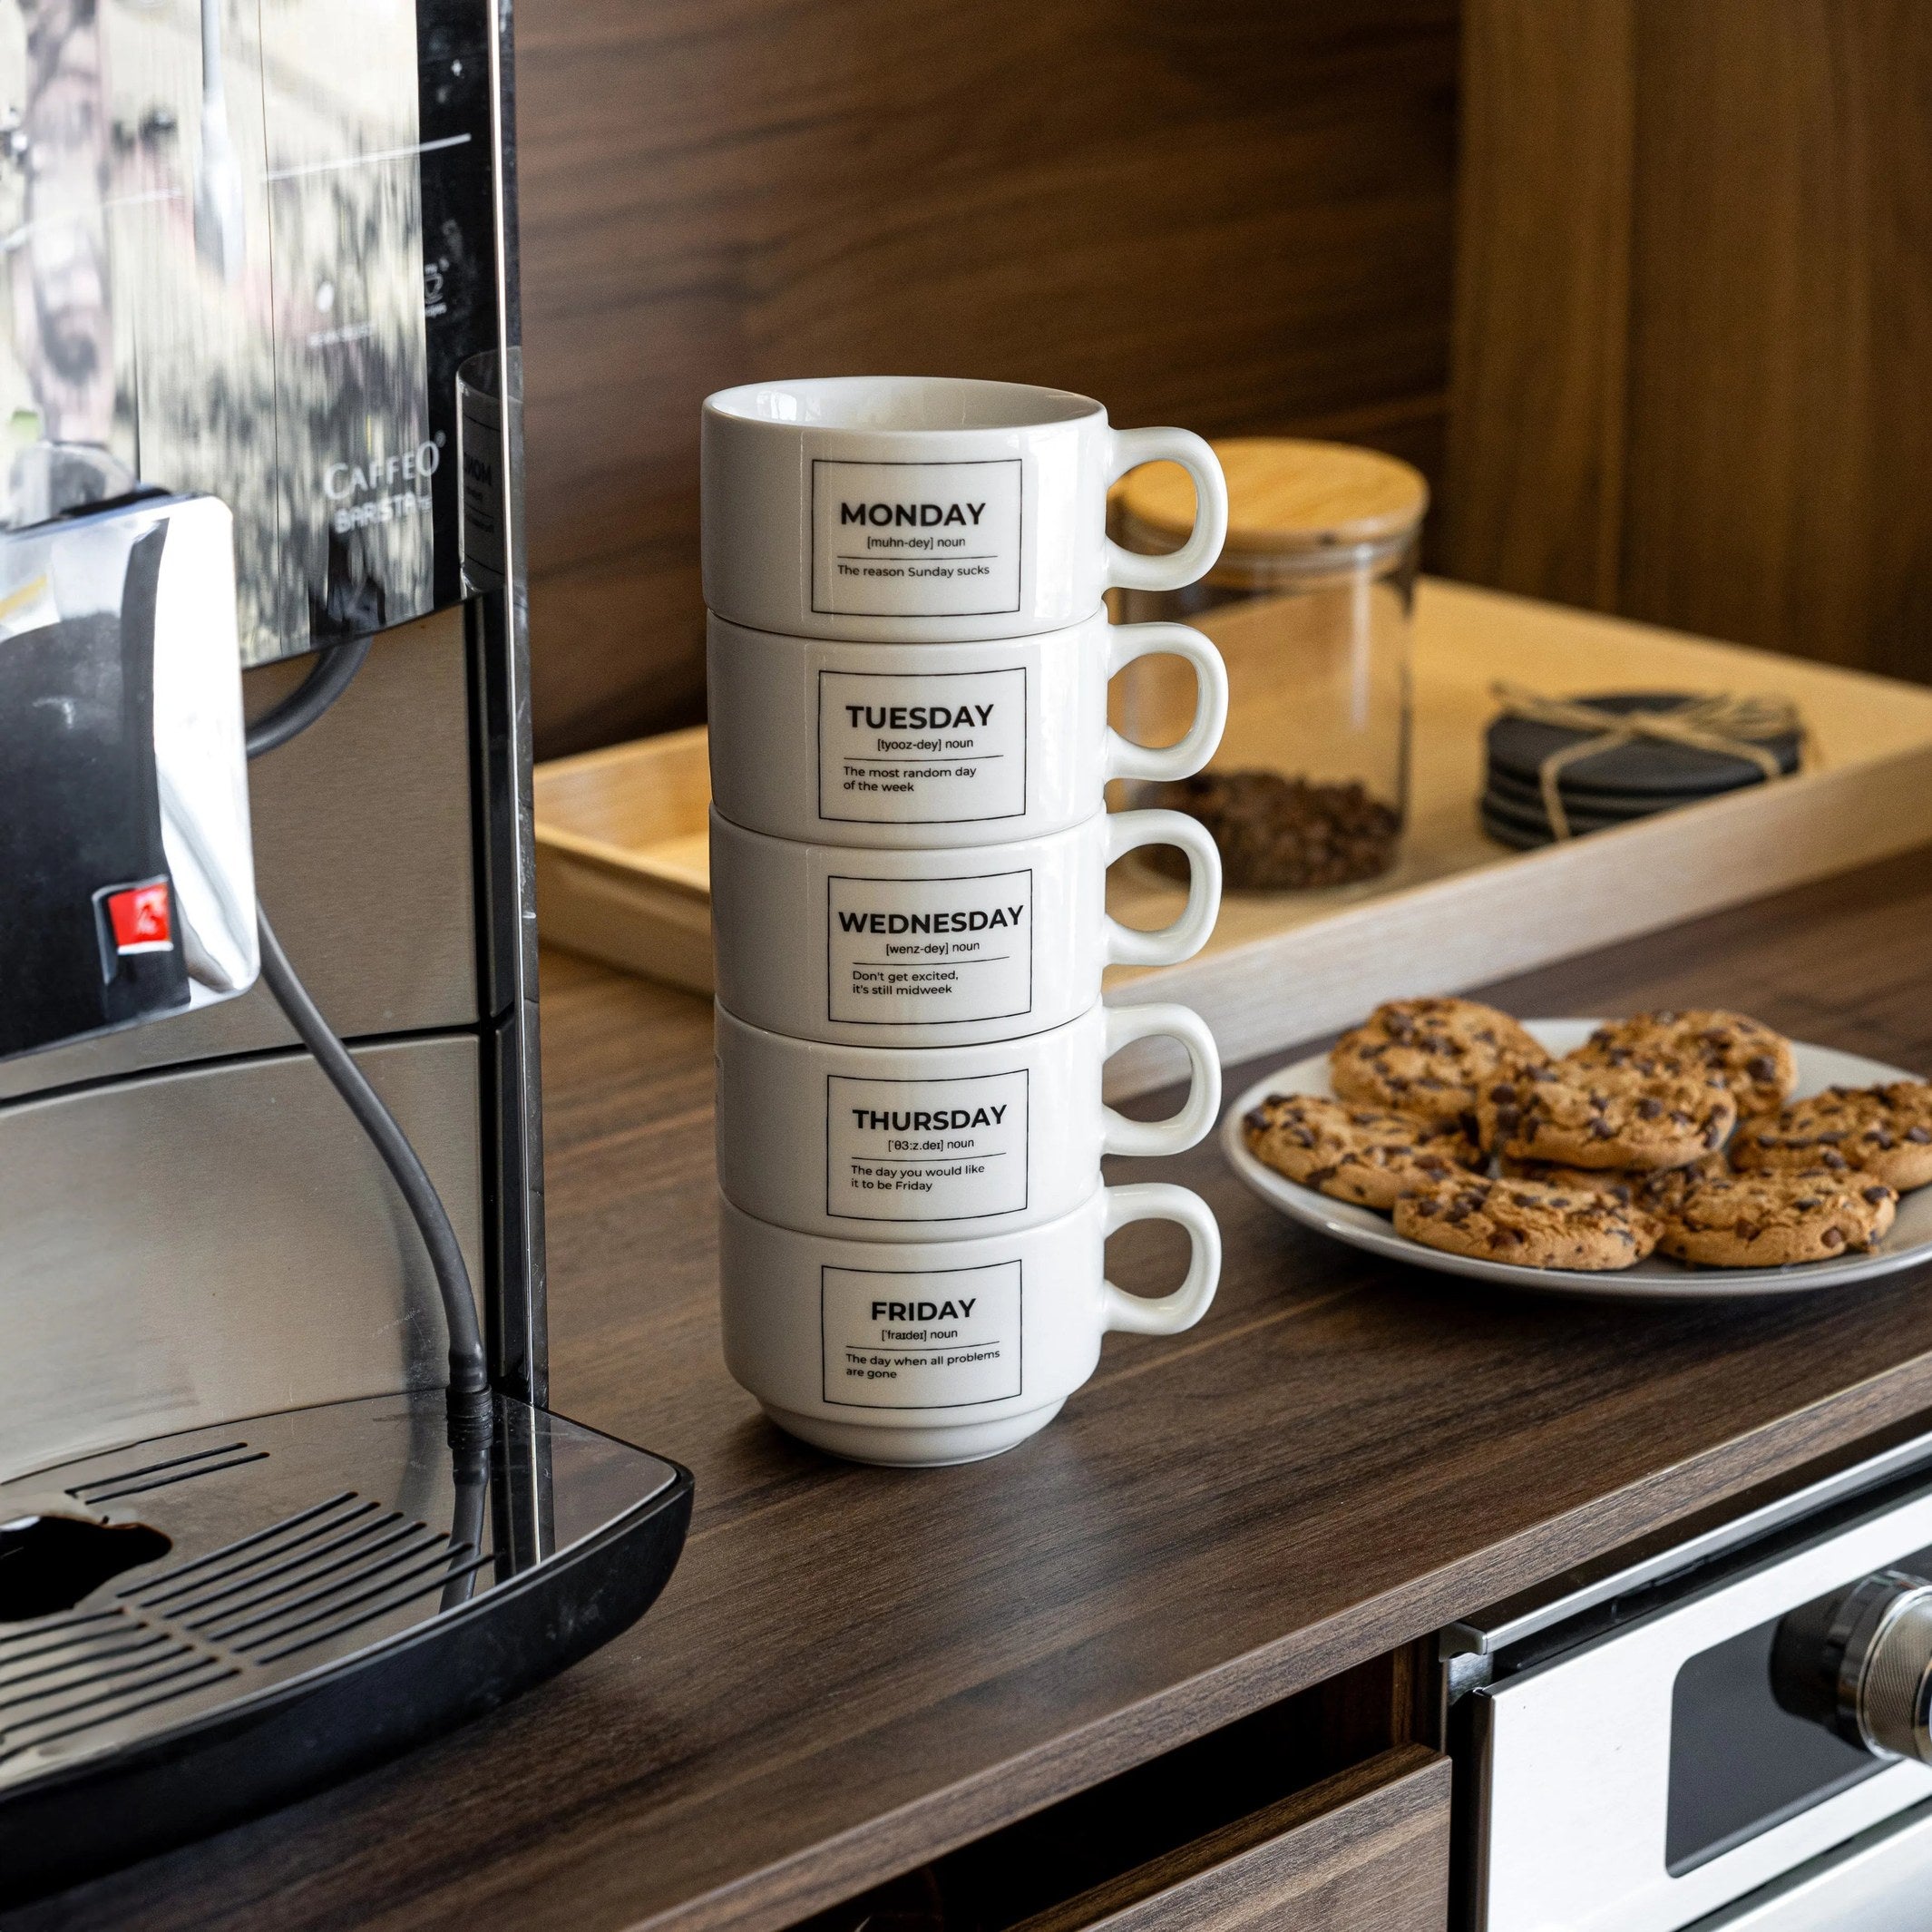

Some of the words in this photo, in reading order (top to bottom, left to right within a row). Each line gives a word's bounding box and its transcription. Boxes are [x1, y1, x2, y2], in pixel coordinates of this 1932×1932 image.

[840, 503, 986, 527] MONDAY
[867, 536, 933, 551] [muhn-dey]
[937, 538, 966, 548] noun
[837, 564, 860, 576] The
[863, 566, 904, 577] reason
[908, 566, 954, 579] Sunday
[956, 564, 990, 576] sucks
[845, 704, 994, 729] TUESDAY
[877, 738, 942, 752] [tyooz-dey]
[945, 738, 974, 748] noun
[844, 766, 865, 777] The
[869, 767, 900, 778] most
[903, 766, 951, 778] random
[955, 766, 977, 778] day
[844, 780, 855, 791] of
[858, 781, 879, 792] the
[882, 781, 915, 792] week
[838, 904, 1024, 934] WEDNESDAY
[885, 942, 949, 956] [wenz-dey]
[952, 941, 981, 952] noun
[853, 971, 884, 981] Don't
[887, 972, 909, 983] get
[912, 970, 959, 981] excited,
[853, 984, 869, 994] it's
[872, 985, 893, 995] still
[895, 984, 952, 995] midweek
[852, 1104, 1008, 1131] THURSDAY
[947, 1139, 975, 1150] noun
[851, 1165, 873, 1176] The
[874, 1166, 898, 1178] day
[900, 1166, 922, 1179] you
[925, 1166, 961, 1177] would
[965, 1164, 985, 1175] like
[851, 1178, 859, 1188] it
[862, 1179, 874, 1189] to
[877, 1178, 893, 1190] be
[895, 1180, 932, 1193] Friday
[871, 1298, 977, 1322] FRIDAY
[930, 1329, 958, 1340] noun
[846, 1353, 867, 1365] The
[870, 1355, 892, 1368] day
[893, 1354, 928, 1366] when
[930, 1354, 944, 1365] all
[947, 1350, 1000, 1367] problems
[846, 1368, 864, 1377] are
[867, 1370, 897, 1380] gone
